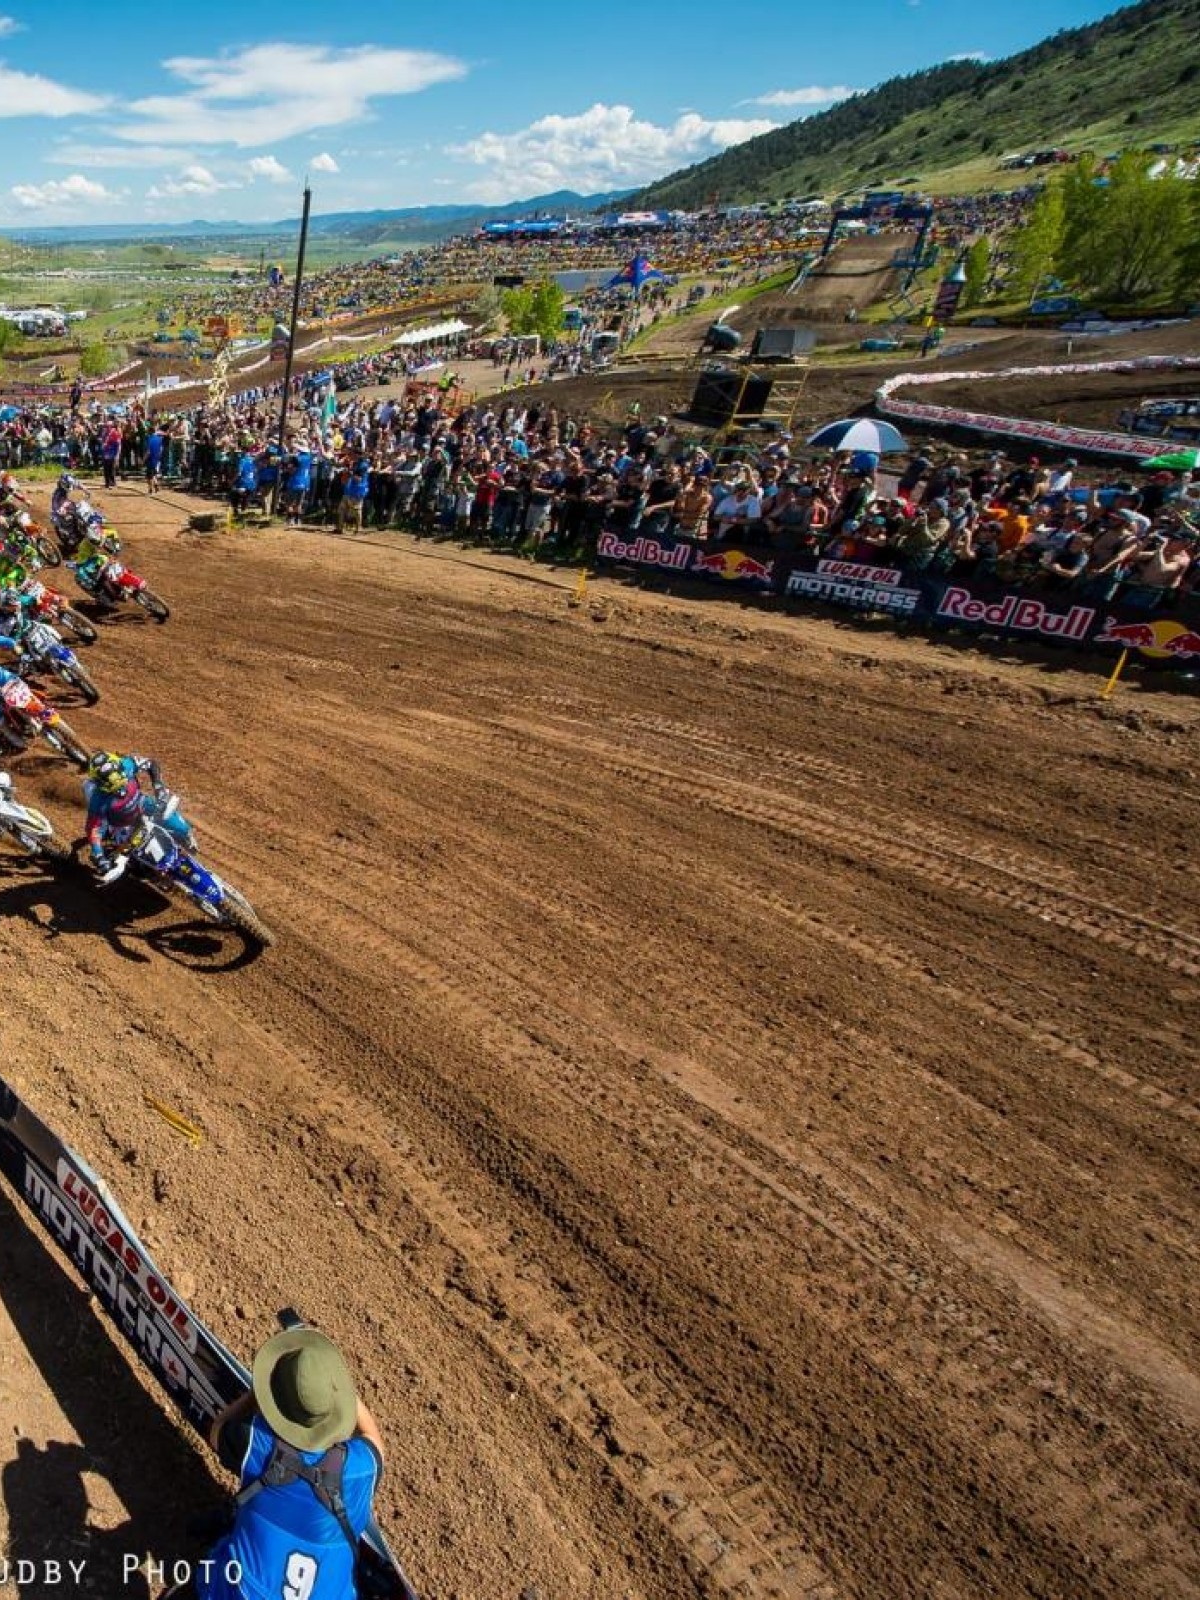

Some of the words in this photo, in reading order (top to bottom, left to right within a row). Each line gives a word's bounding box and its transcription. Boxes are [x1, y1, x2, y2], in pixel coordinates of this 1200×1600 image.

[787, 576, 918, 609] MOTOCROSS
[820, 561, 870, 580] LUCAS
[871, 567, 898, 584] OIL
[61, 1171, 141, 1275] LUCAS
[145, 1274, 191, 1343] OIL
[24, 1160, 218, 1420] MOTOCROS
[283, 1551, 318, 1600] 9
